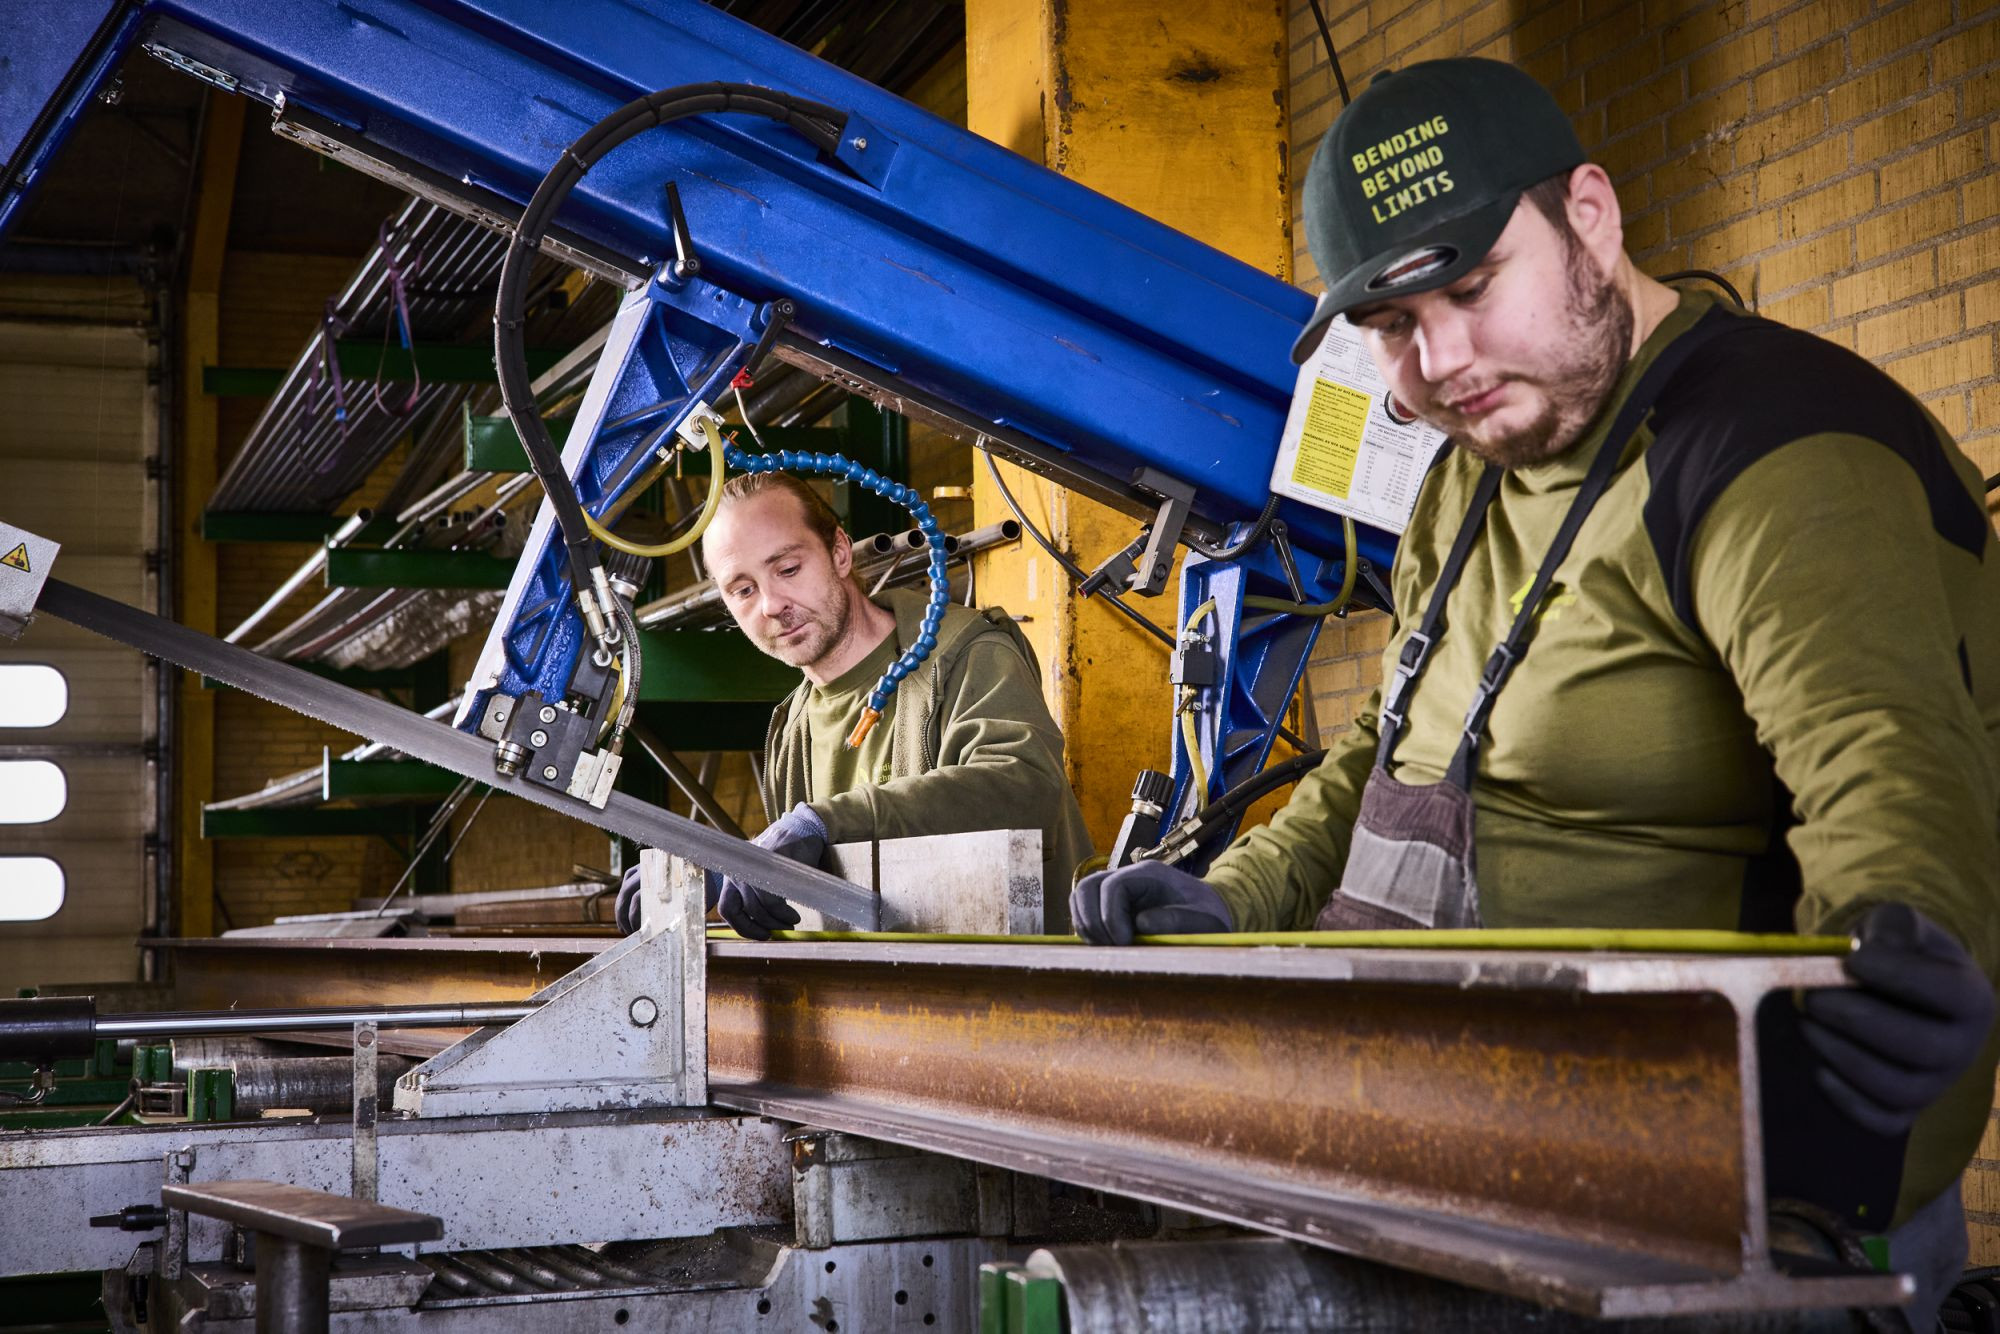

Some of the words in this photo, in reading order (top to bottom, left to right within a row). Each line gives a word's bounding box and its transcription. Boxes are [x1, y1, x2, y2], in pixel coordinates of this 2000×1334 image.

[1352, 115, 1449, 174] BENDING
[1361, 146, 1444, 199] BEYOND
[1371, 170, 1455, 224] LIMITS
